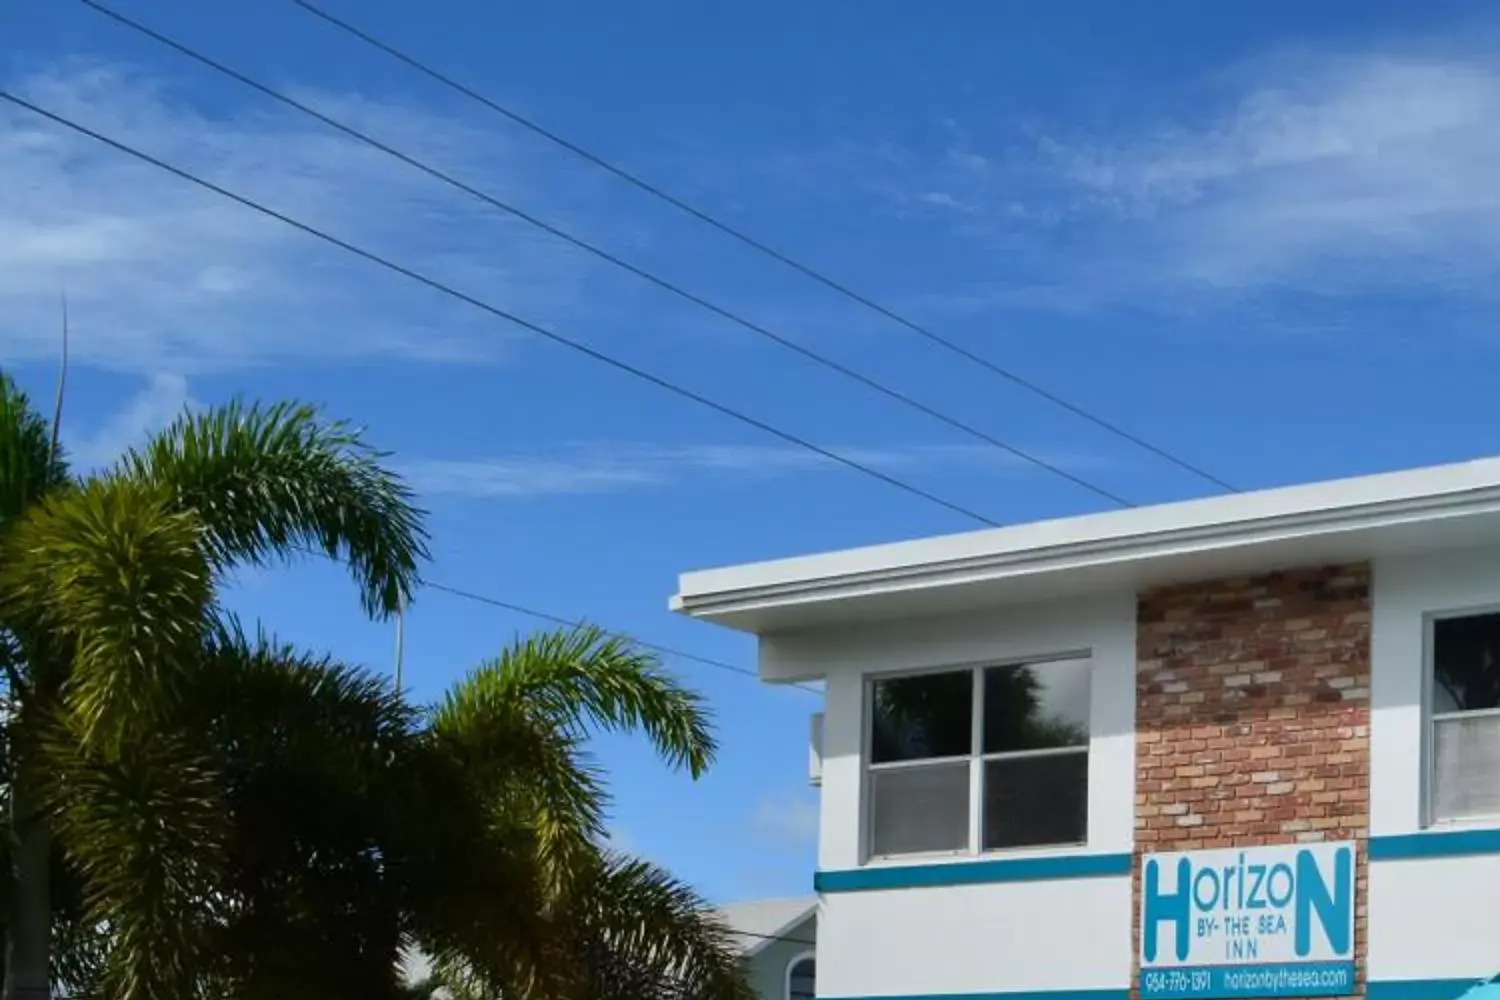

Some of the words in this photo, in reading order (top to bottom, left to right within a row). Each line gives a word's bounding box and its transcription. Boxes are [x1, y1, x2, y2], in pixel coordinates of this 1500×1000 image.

[1143, 847, 1351, 962] HorizoN
[1224, 915, 1250, 936] THE
[1258, 914, 1287, 935] SEA
[1225, 939, 1258, 960] INN
[1223, 967, 1347, 992] horizonbythesea.com
